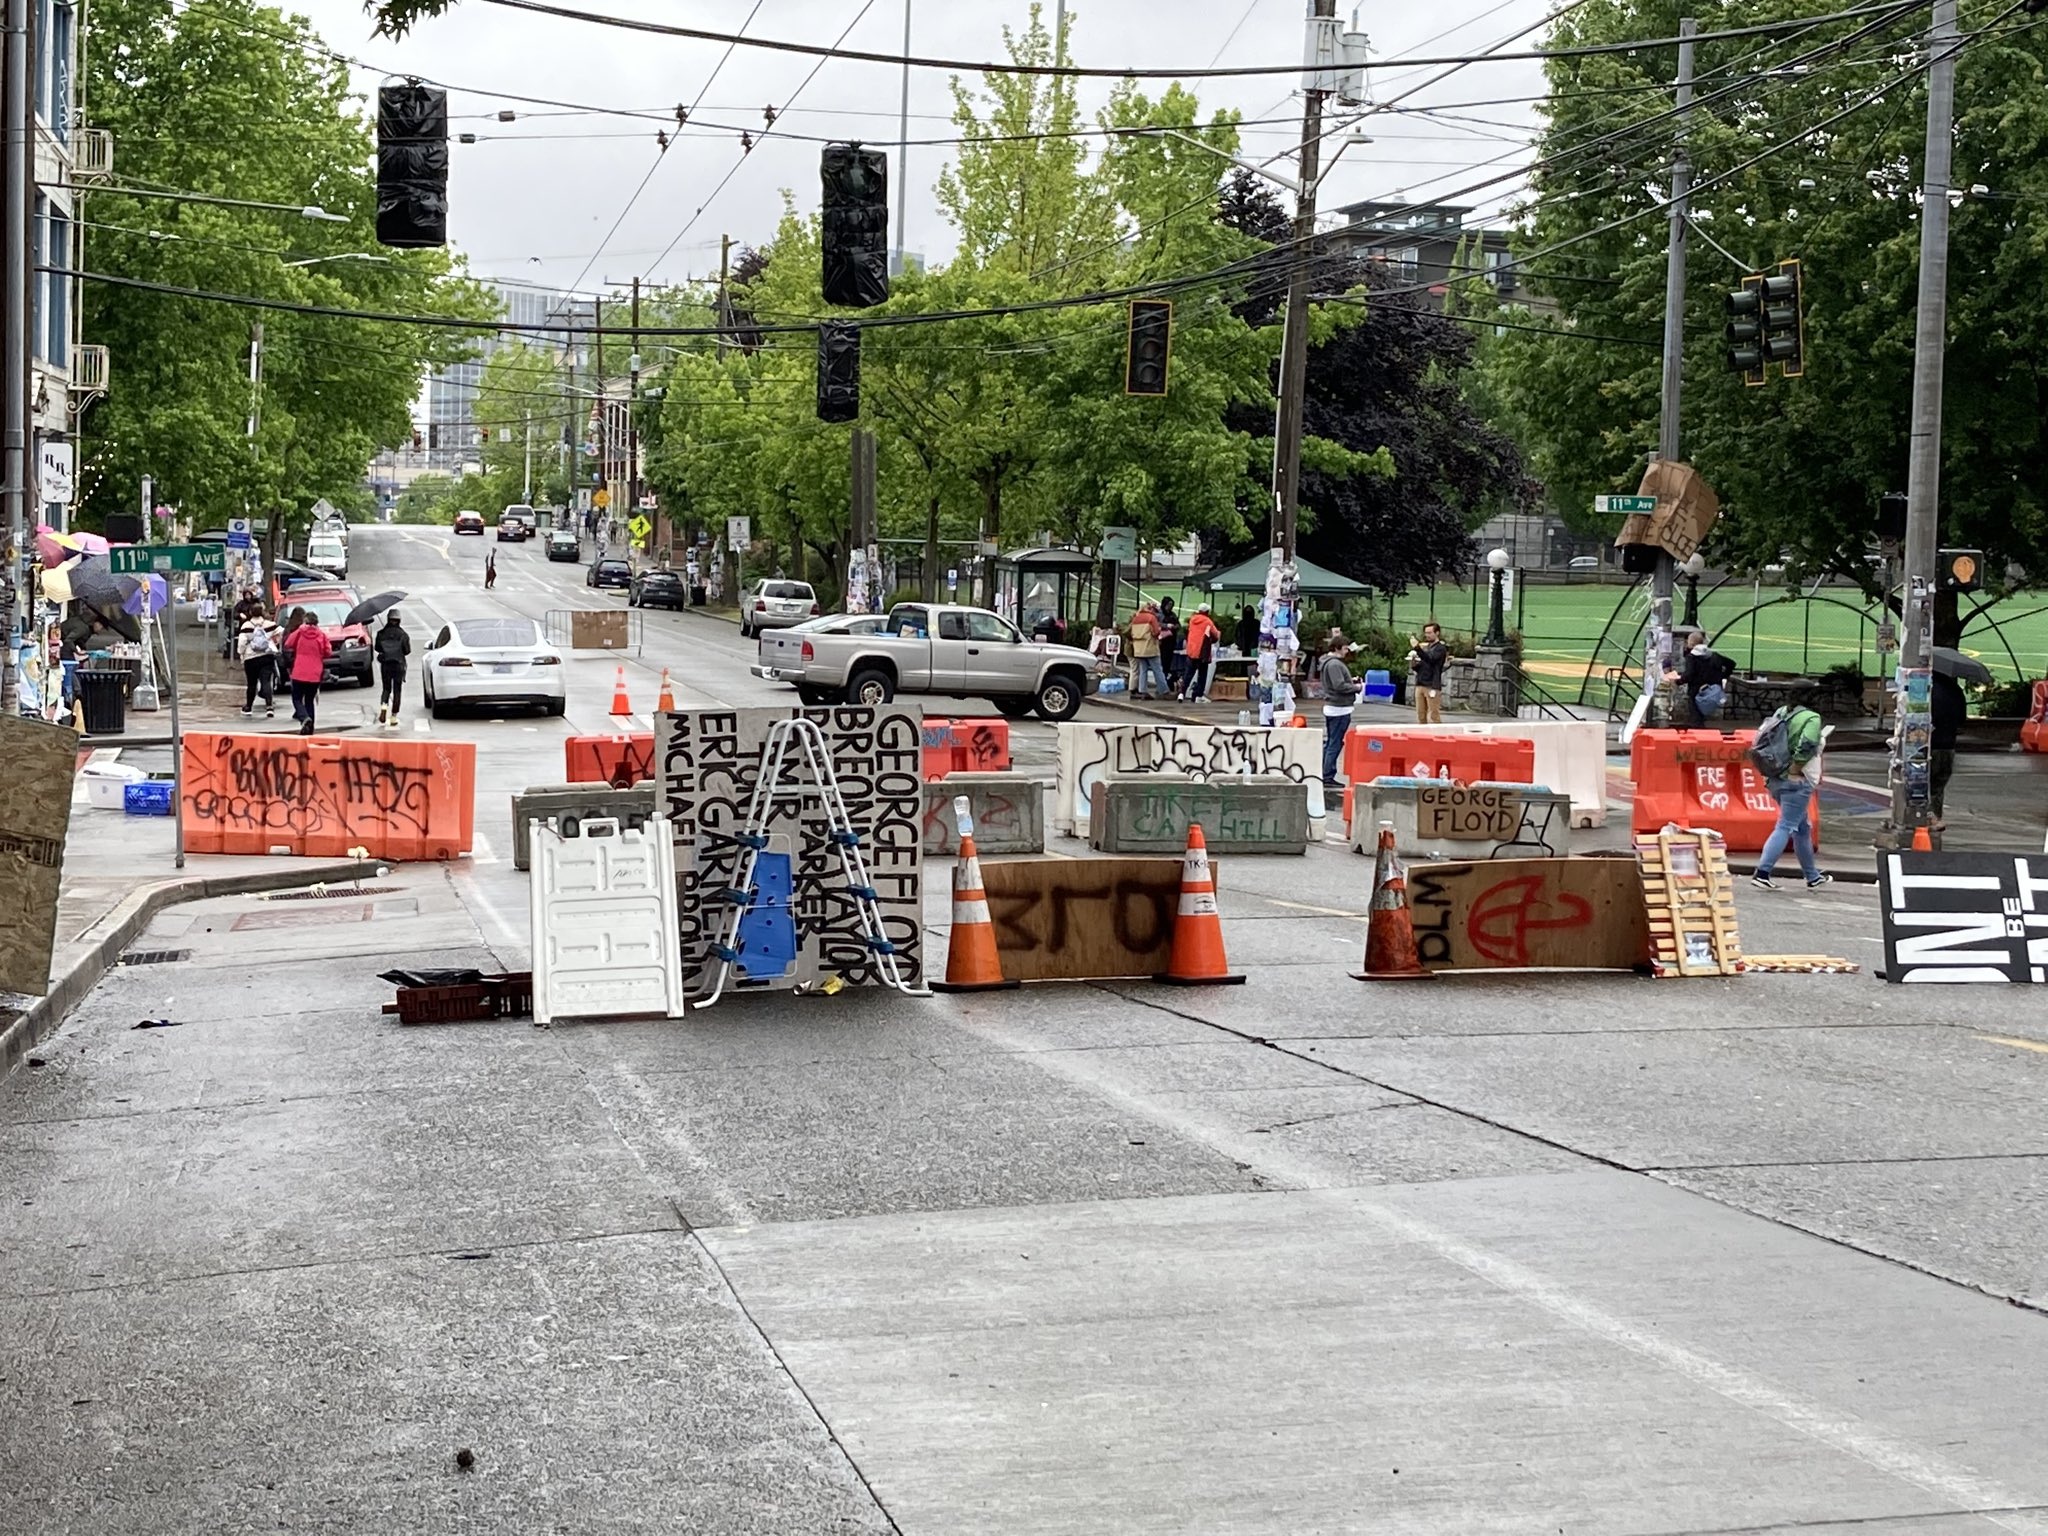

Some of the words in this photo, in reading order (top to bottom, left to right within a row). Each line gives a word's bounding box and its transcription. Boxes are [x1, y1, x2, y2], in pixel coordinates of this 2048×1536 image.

[1637, 500, 1653, 510] Ave
[117, 549, 149, 571] 11th
[193, 551, 219, 566] Ave
[698, 712, 738, 792] ERIC
[872, 714, 920, 867] GEORGE
[1422, 788, 1513, 808] GEORGE
[1699, 791, 1729, 811] CAP
[1220, 818, 1287, 840] HILL
[1433, 808, 1514, 833] FLOYD
[798, 819, 829, 941] PARKER
[2002, 898, 2025, 937] BE
